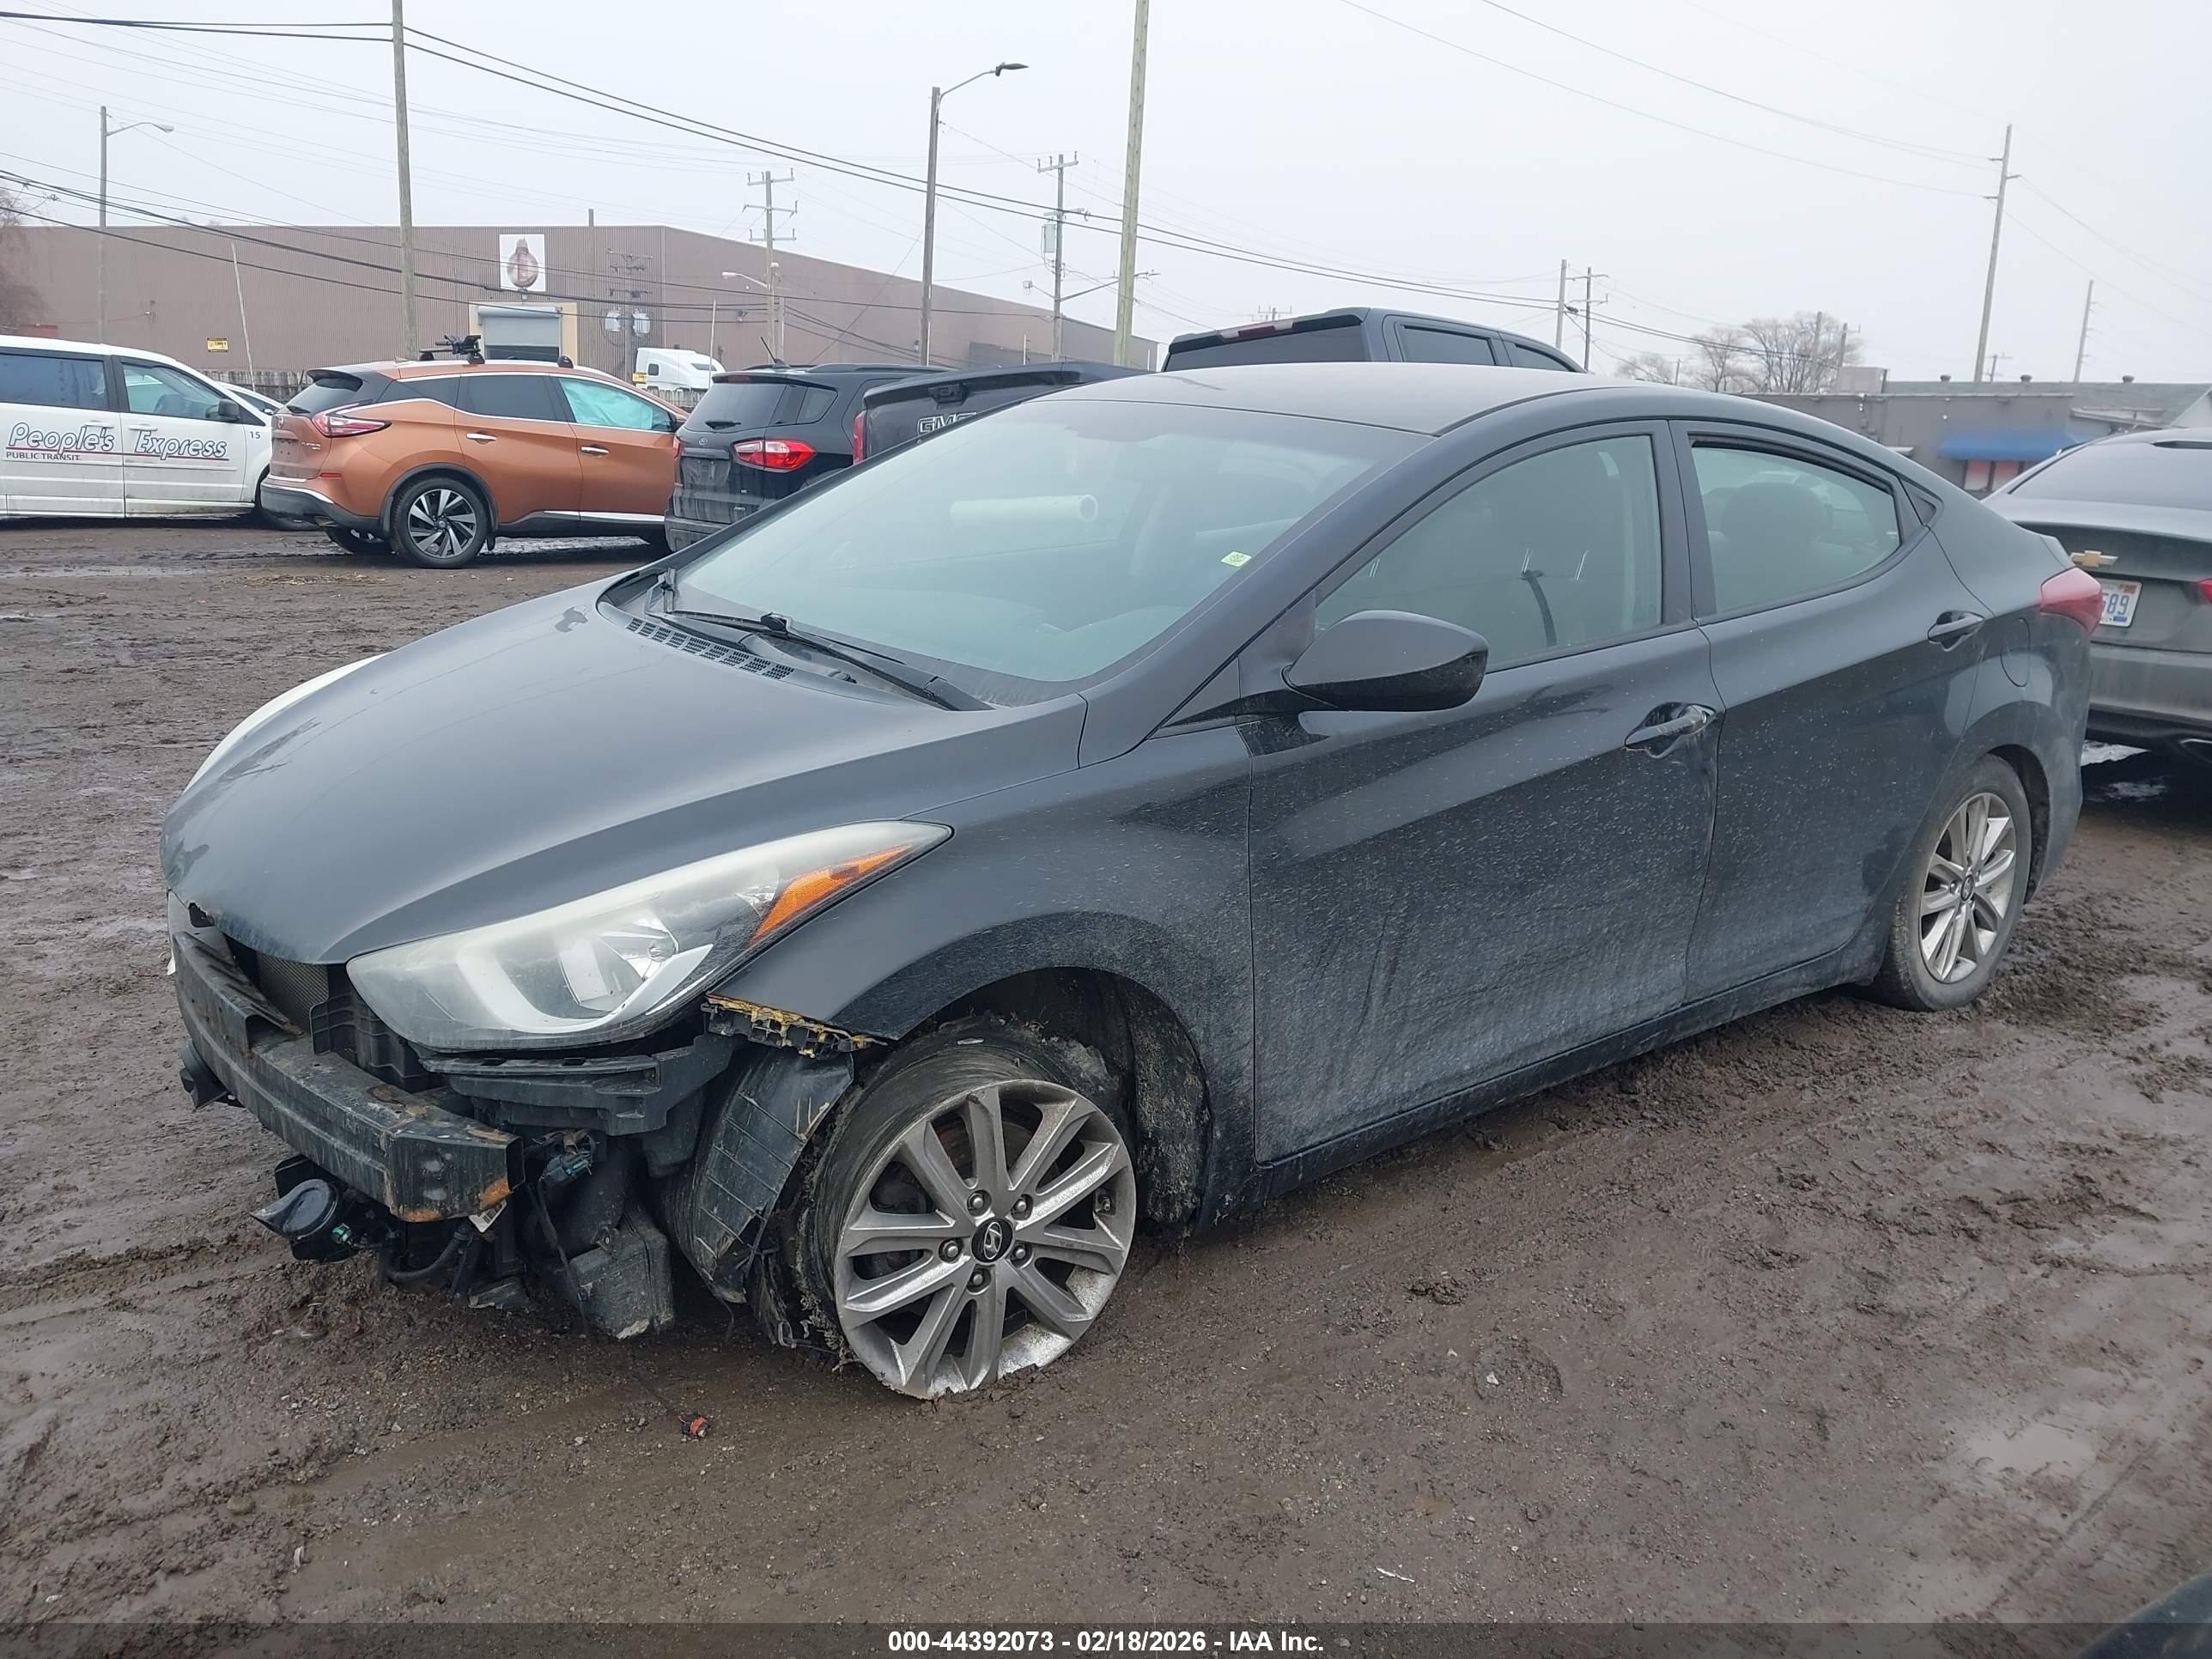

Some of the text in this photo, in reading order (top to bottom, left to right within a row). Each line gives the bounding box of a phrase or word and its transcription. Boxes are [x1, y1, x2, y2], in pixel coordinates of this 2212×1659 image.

[9, 422, 228, 460] People's Express
[6, 451, 81, 461] PUBLIC TRANSIT
